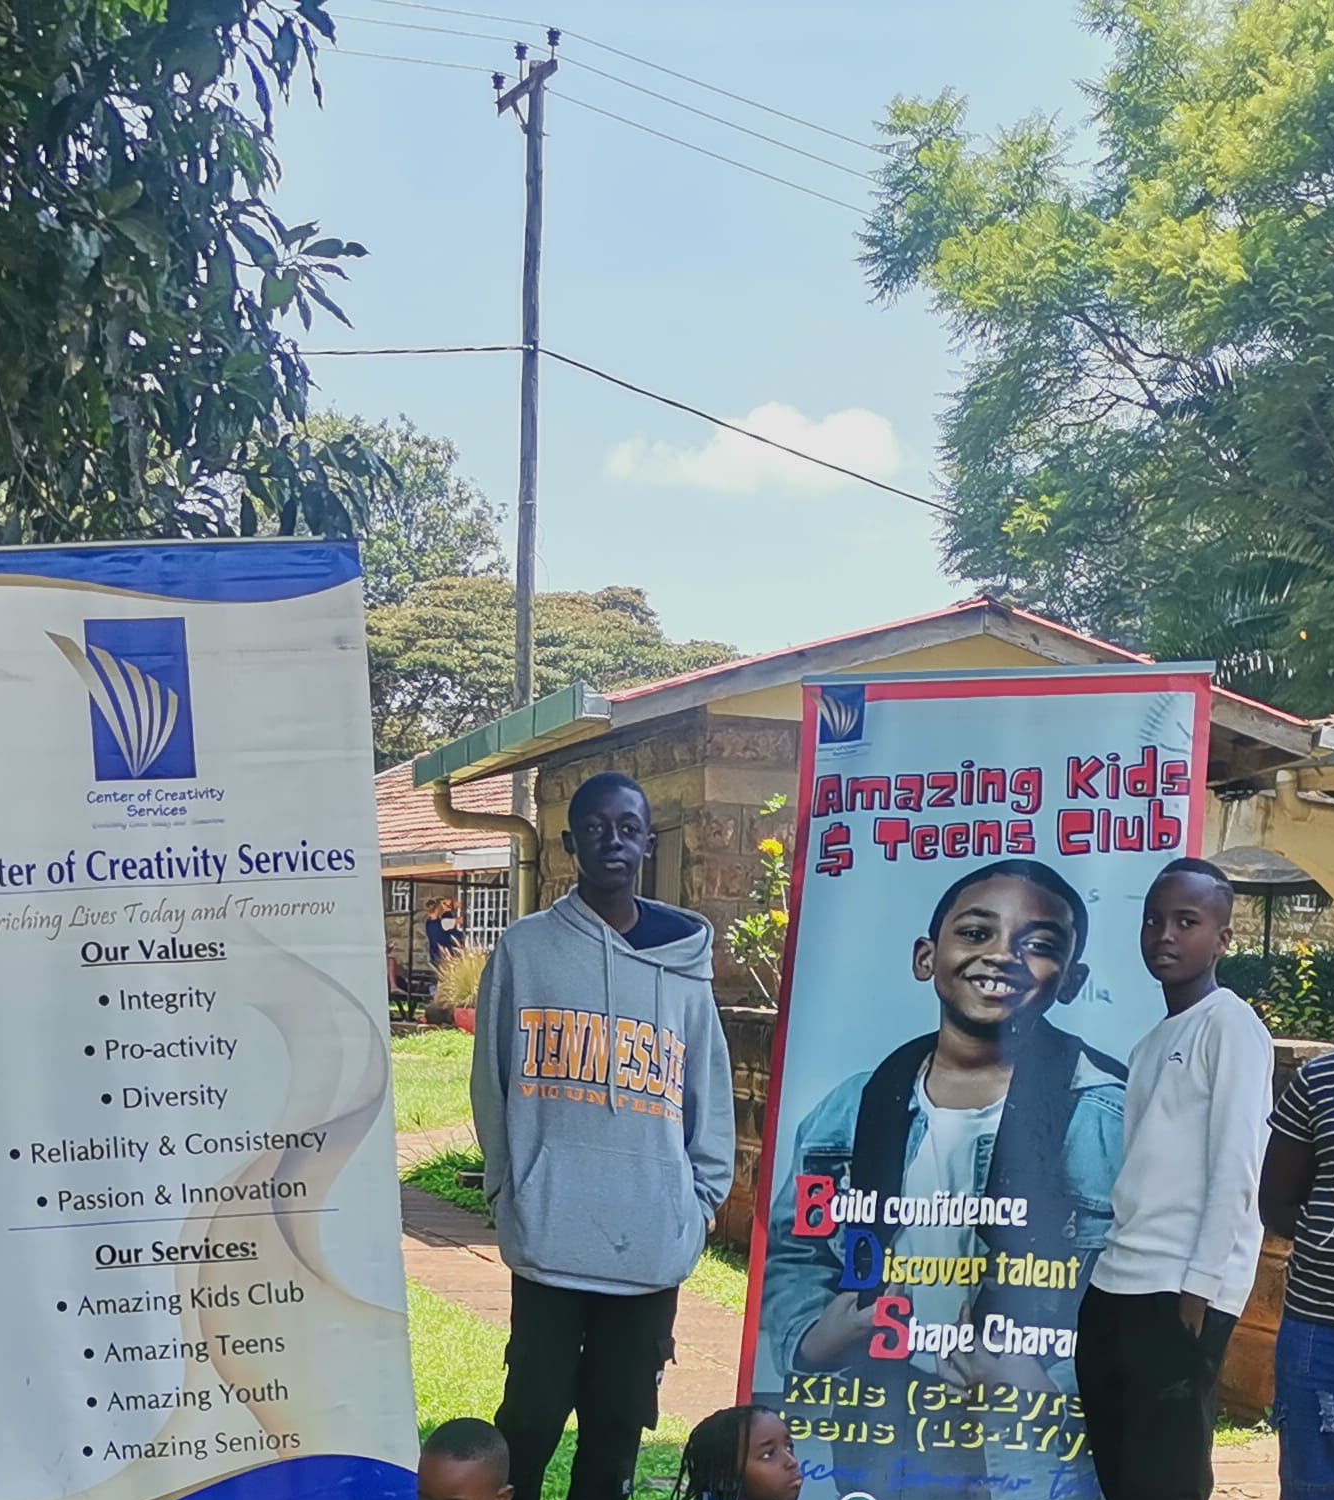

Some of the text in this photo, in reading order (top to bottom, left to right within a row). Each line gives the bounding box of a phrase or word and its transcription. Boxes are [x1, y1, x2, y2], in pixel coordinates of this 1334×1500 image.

[87, 787, 225, 804] Center of Creativity
[813, 745, 1190, 818] Amazing Kids
[127, 804, 187, 817] Services
[873, 816, 1035, 861] Teens
[1057, 799, 1181, 856] Club
[48, 850, 76, 884] of
[86, 846, 227, 884] Creativity
[238, 839, 356, 873] Services
[68, 903, 117, 929] Lives
[124, 896, 185, 934] Today
[192, 894, 232, 921] and
[233, 895, 336, 919] Tomorrow
[80, 938, 226, 963] Our Values:
[120, 986, 216, 1014] Integrity
[105, 1034, 238, 1061] Pro-activity
[123, 1084, 228, 1110] Diversity
[31, 1129, 327, 1164] Reliability & Consistency
[58, 1177, 307, 1212] Passion & Innovation
[792, 1175, 1027, 1237] Build confidence
[95, 1238, 258, 1266] Our Services:
[838, 1228, 1080, 1291] Discover talent
[77, 1281, 304, 1317] Amazing Kids Club
[869, 1297, 1078, 1360] Shape Chara
[104, 1334, 285, 1364] Amazing Teens
[107, 1379, 289, 1412] Amazing Youth
[786, 1377, 886, 1409] Kids
[103, 1429, 301, 1462] Amazing Seniors
[779, 1411, 1093, 1461] eens (13-17y
